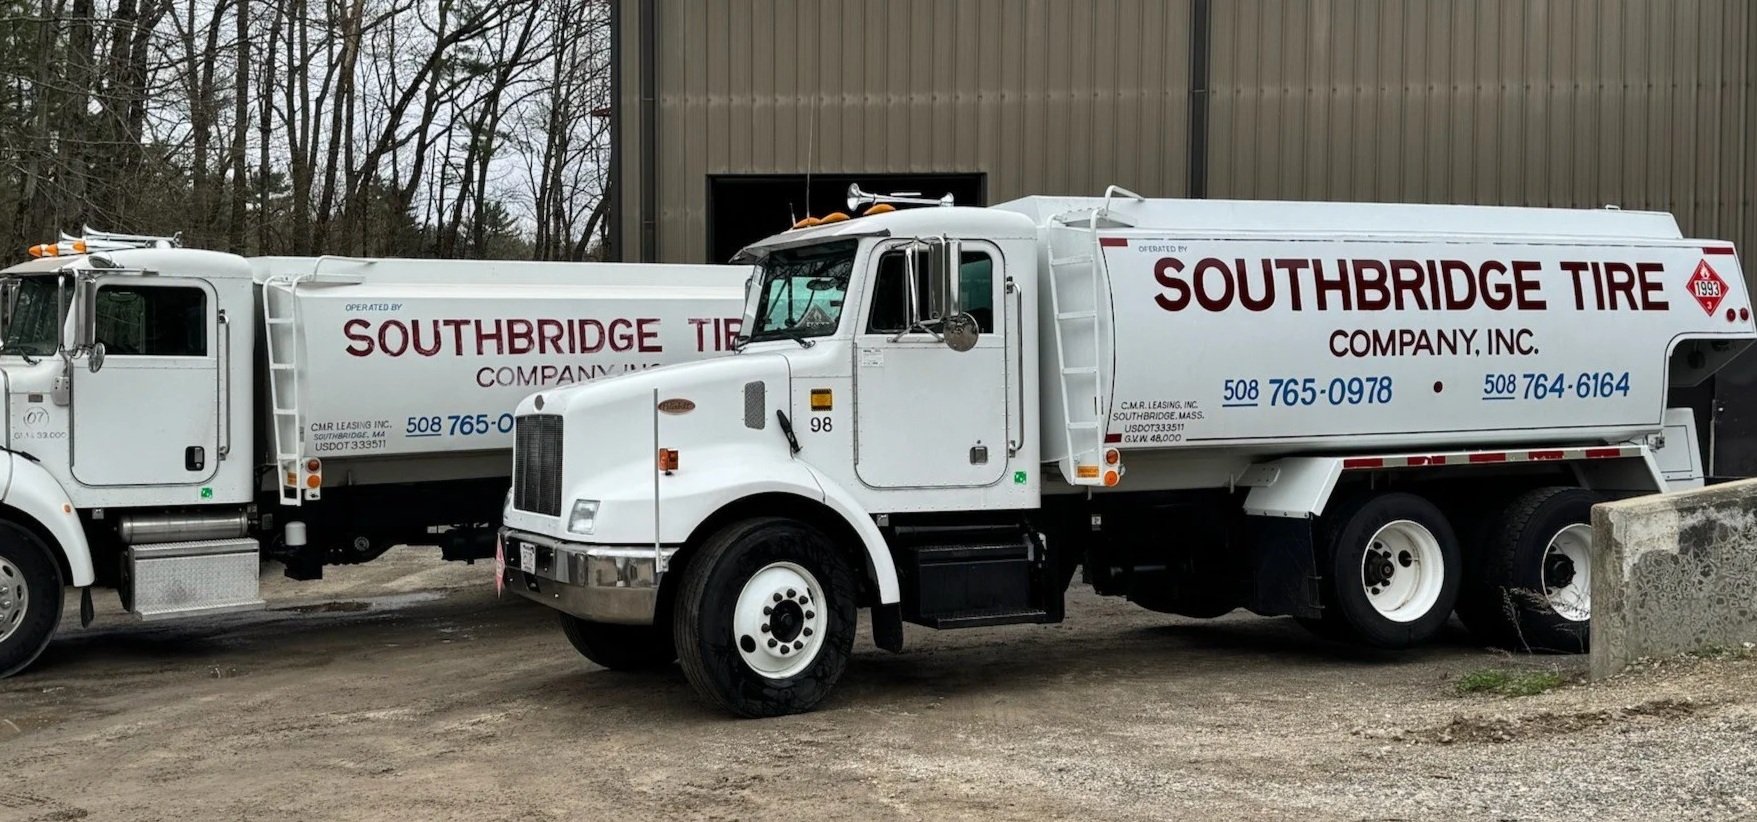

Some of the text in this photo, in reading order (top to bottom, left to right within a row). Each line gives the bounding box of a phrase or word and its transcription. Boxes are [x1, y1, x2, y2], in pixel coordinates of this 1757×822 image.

[1153, 257, 1670, 312] SOUTHBRIDGE TIRE
[1696, 281, 1720, 296] 1993
[345, 303, 403, 312] OPERATED BY
[1706, 301, 1713, 310] 3
[343, 318, 743, 357] SOUTHBRIDGE TIR
[1329, 328, 1539, 358] COMPANY, INC.
[1223, 375, 1393, 407] 508 765-0978
[1483, 371, 1630, 400] 508 764-6164
[405, 413, 514, 436] 508 765-0
[810, 416, 833, 433] 98
